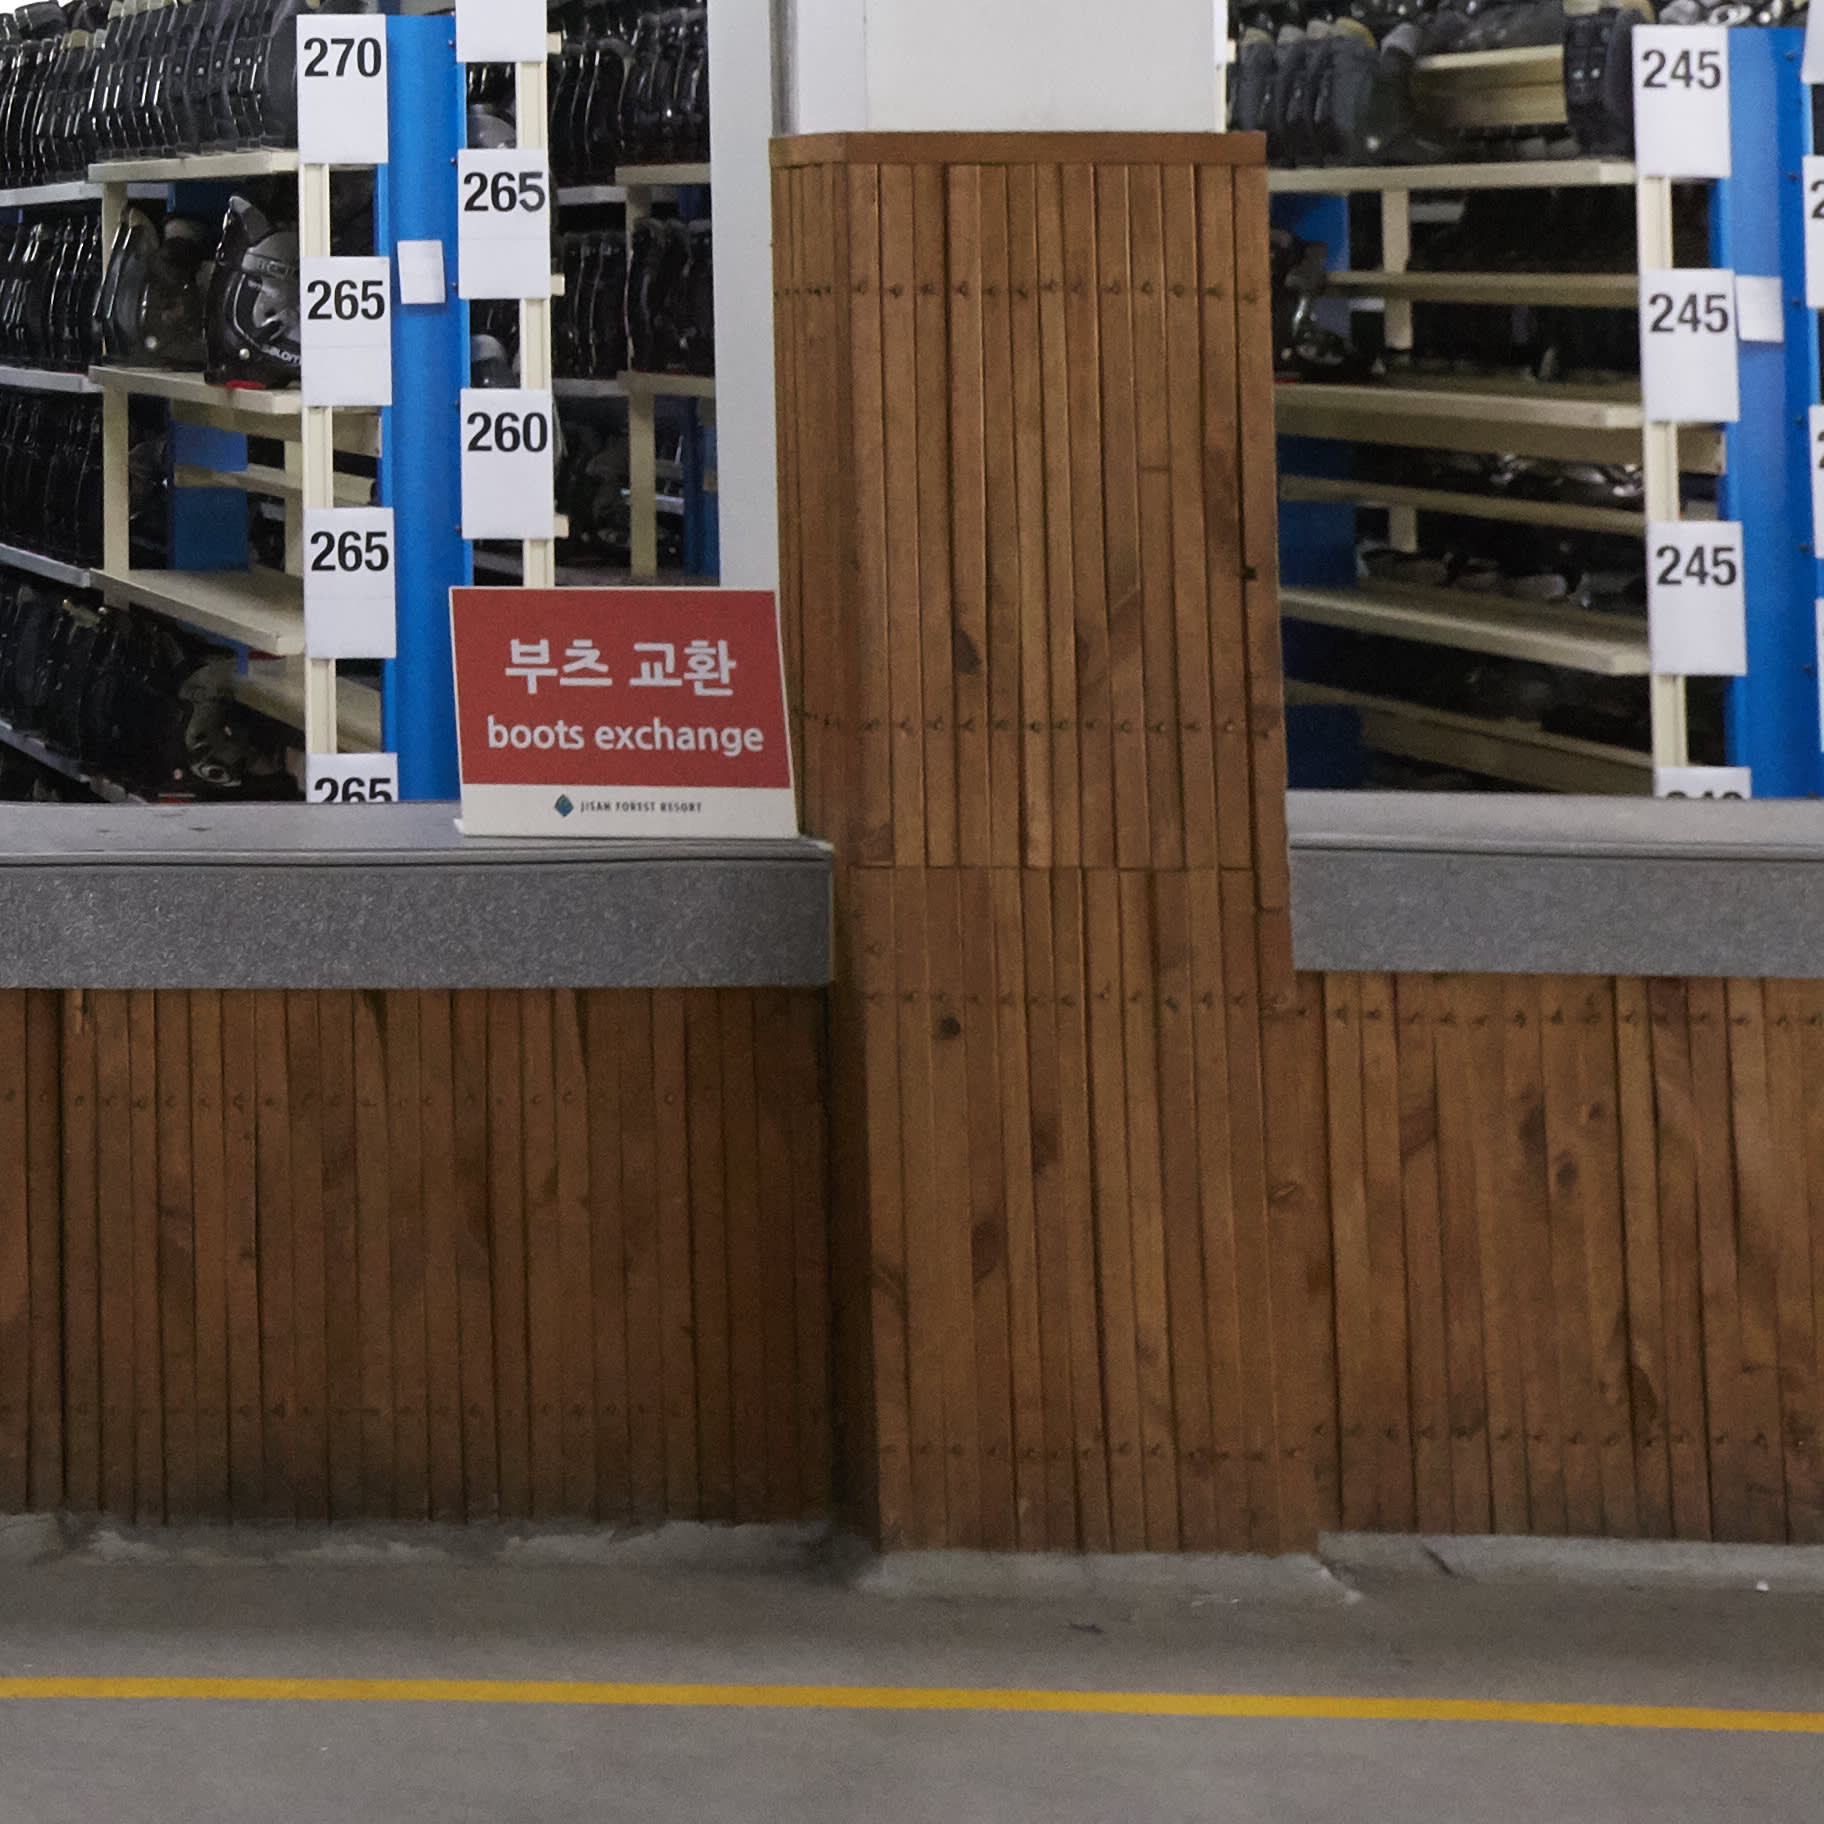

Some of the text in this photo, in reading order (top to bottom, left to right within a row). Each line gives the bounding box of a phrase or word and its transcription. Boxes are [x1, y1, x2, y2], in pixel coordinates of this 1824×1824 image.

[304, 38, 381, 77] 270
[1643, 50, 1721, 89] 245
[464, 172, 545, 212] 265
[308, 280, 385, 320] 265
[1650, 294, 1728, 333] 245
[467, 412, 547, 452] 260
[311, 531, 389, 571] 265
[1657, 546, 1736, 586] 245
[505, 639, 736, 696] 부츠 교환
[488, 716, 763, 756] boots exchange
[616, 801, 656, 813] FOREST
[660, 801, 702, 813] RESORT
